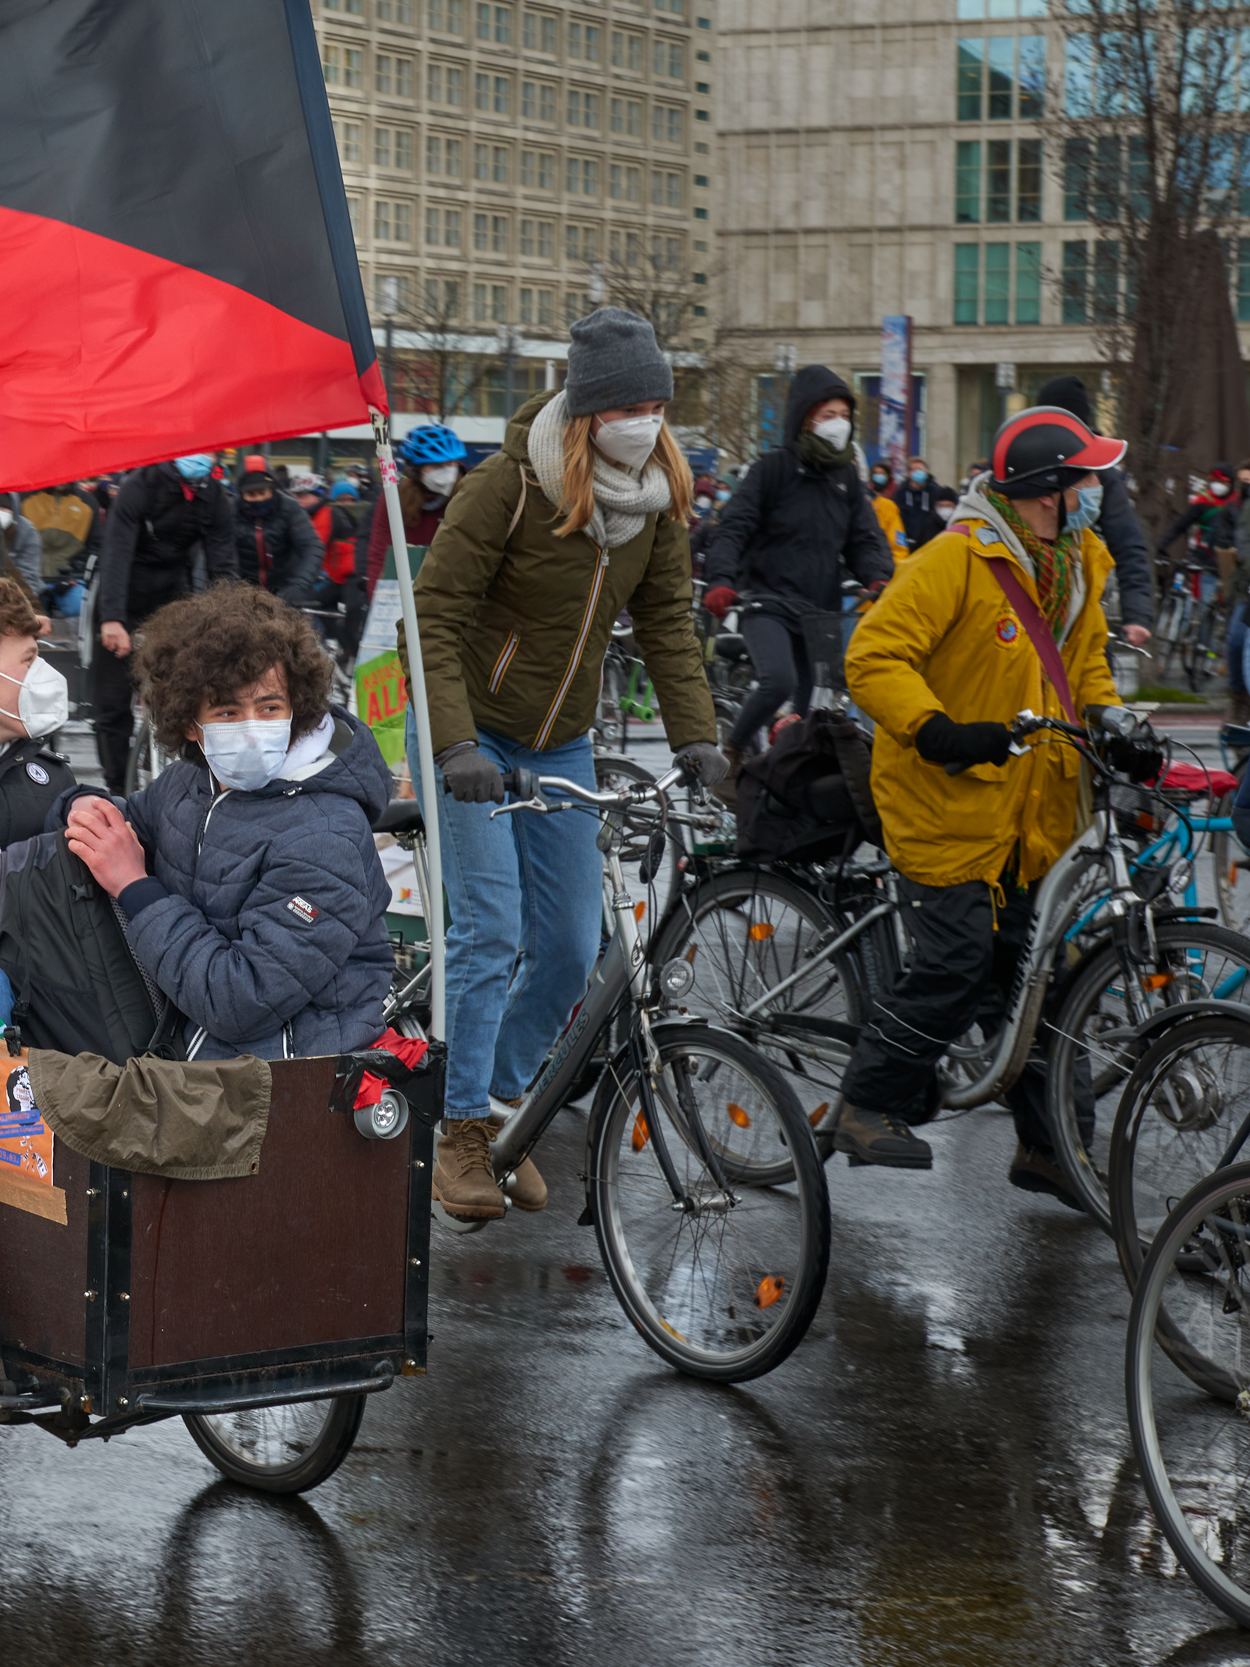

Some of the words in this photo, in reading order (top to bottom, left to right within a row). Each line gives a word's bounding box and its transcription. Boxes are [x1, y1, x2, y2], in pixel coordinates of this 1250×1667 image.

[531, 1008, 590, 1106] HERCULES
[0, 1112, 30, 1122] KLIMASCHUTZ
[0, 1149, 19, 1164] 19.03.
